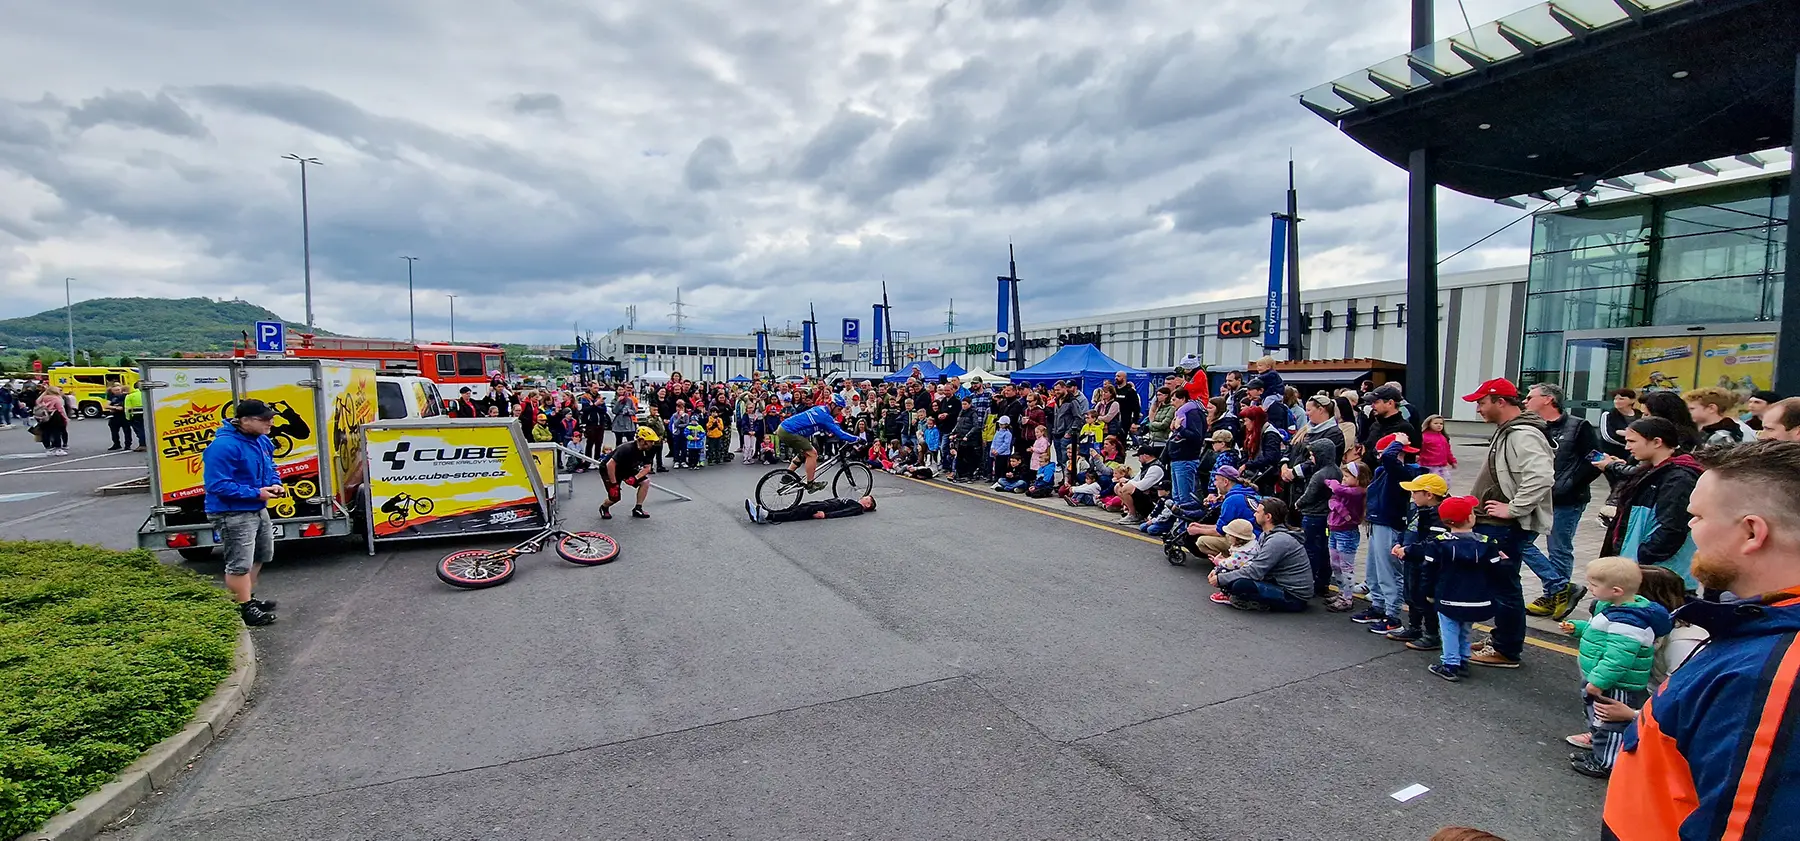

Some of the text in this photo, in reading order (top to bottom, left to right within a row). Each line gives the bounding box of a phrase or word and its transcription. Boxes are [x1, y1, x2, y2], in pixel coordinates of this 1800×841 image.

[1268, 290, 1277, 335] olympia
[262, 325, 278, 342] P
[846, 321, 856, 335] P
[1219, 319, 1253, 335] CCC
[173, 413, 215, 428] SHOCK!
[162, 428, 216, 447] TRIA
[162, 440, 213, 458] SHO
[413, 446, 509, 462] CUBE
[186, 457, 202, 475] TE
[381, 470, 507, 482] www.cube-store.cz
[179, 487, 204, 497] Martin
